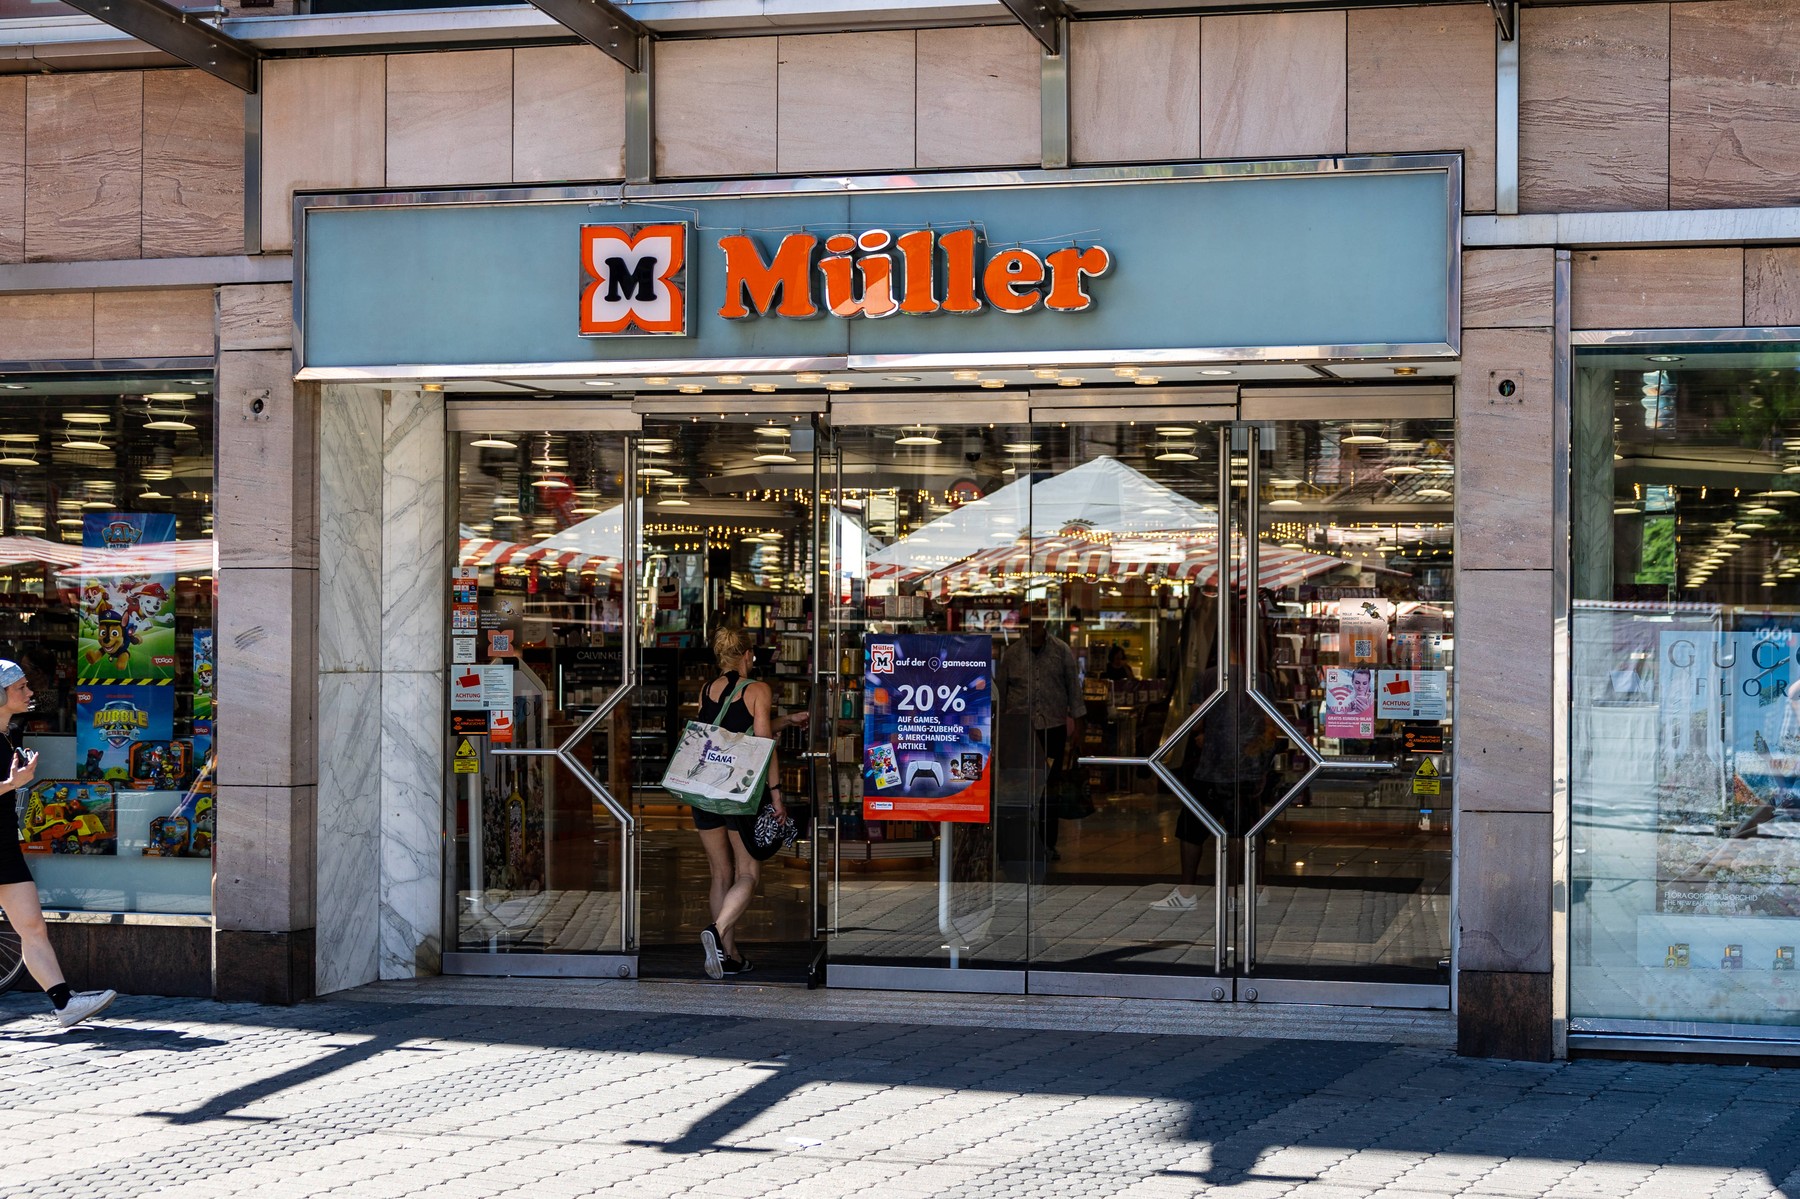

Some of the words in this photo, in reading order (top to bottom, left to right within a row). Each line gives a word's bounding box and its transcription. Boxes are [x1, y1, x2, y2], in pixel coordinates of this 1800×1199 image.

[604, 256, 658, 302] M
[717, 228, 1112, 320] Müller
[101, 526, 143, 543] PAW
[577, 651, 607, 660] CALVIN
[608, 652, 622, 660] KLE
[1668, 639, 1800, 670] GUC
[877, 657, 888, 667] M
[896, 658, 910, 666] auf
[911, 658, 926, 666] der
[942, 660, 986, 669] gamescom
[1696, 677, 1800, 698] FLOR
[93, 709, 149, 729] RUBBLE
[913, 716, 941, 725] GAMES,
[897, 724, 964, 733] GAMING-ZUBEHÖR
[905, 734, 960, 742] MERCHANDISE-
[897, 742, 927, 750] ARTIKEL
[1664, 891, 1687, 899] FLORA
